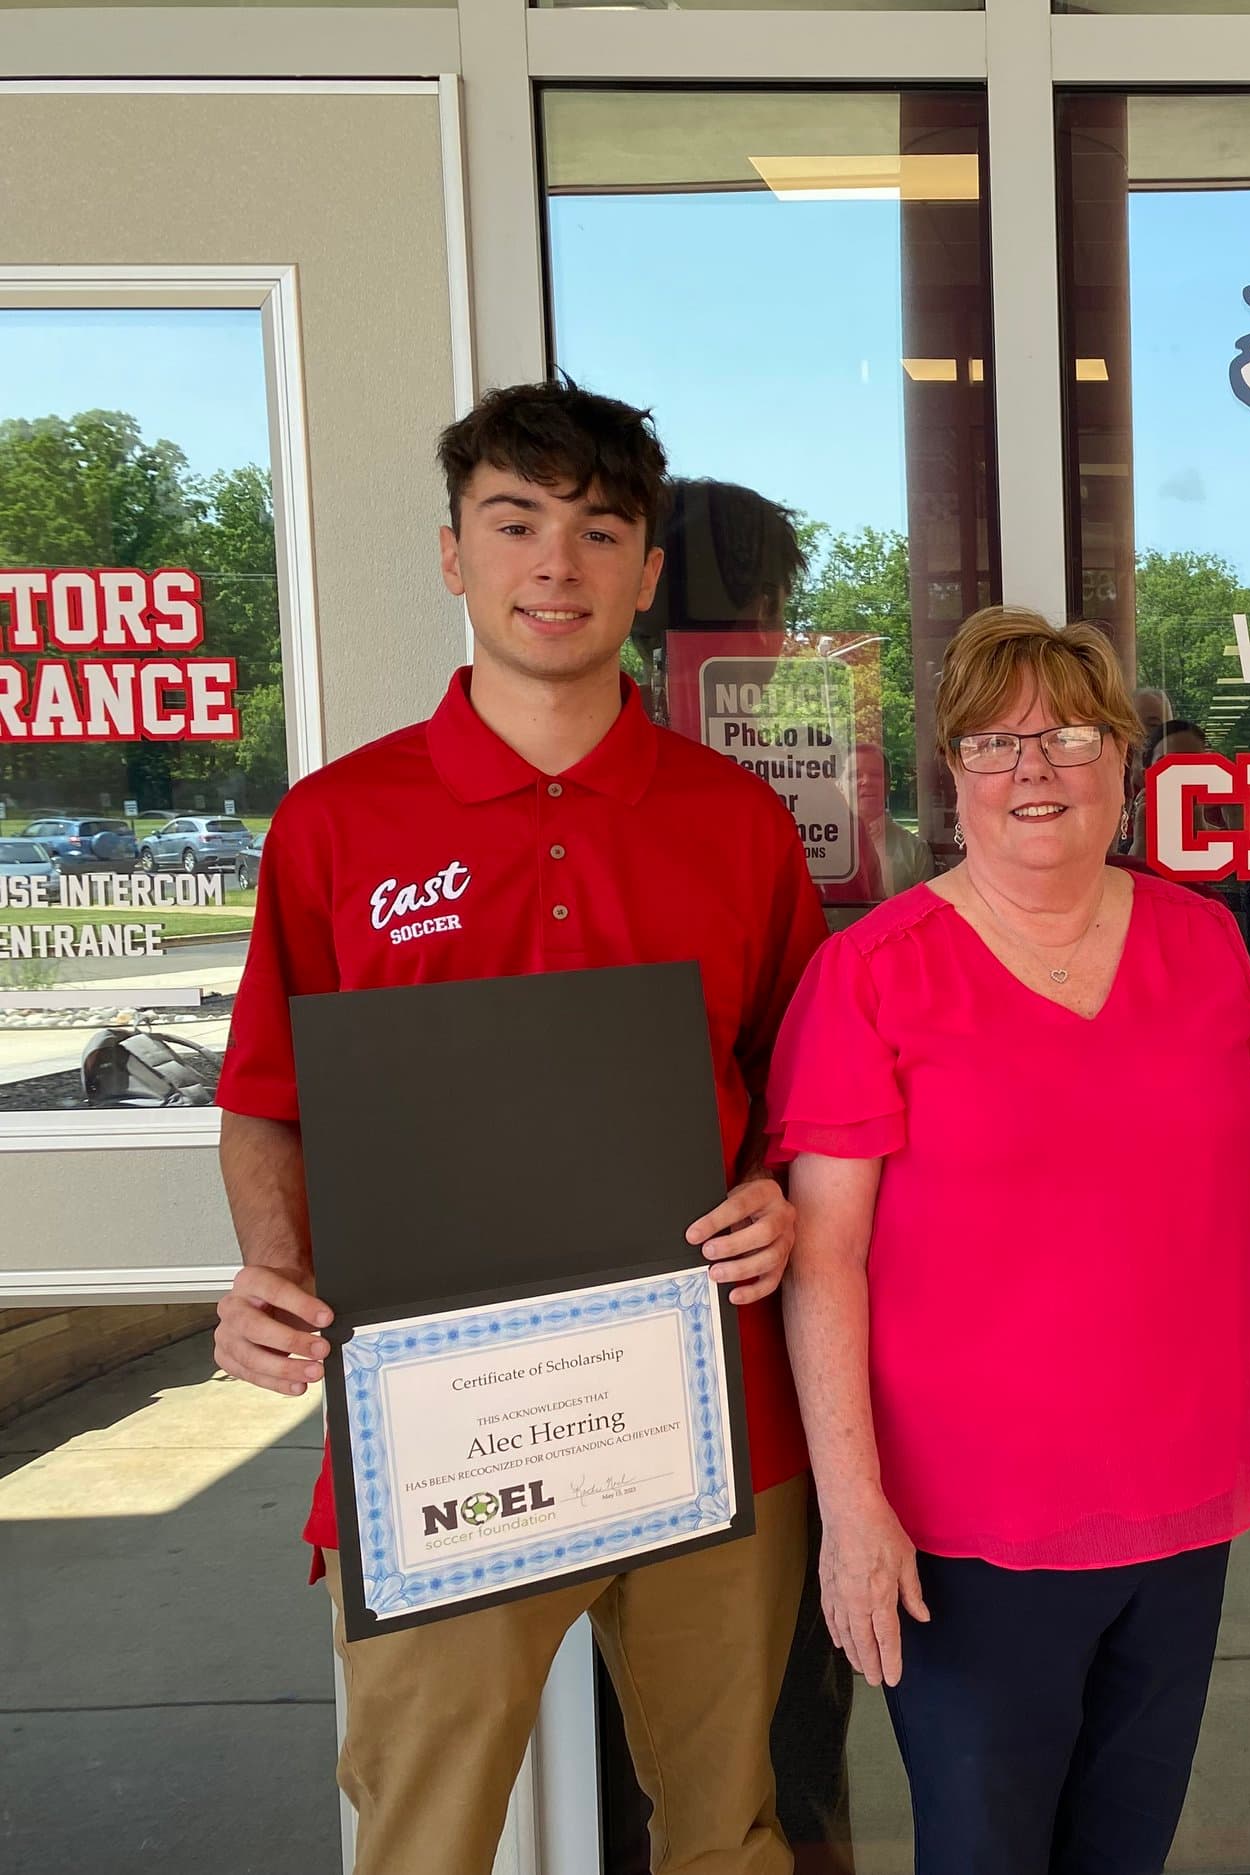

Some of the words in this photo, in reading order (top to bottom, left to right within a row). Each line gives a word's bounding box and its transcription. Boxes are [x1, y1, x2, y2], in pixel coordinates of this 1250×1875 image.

[715, 683, 841, 714] NOTICE
[724, 722, 798, 747] Photo
[807, 722, 833, 747] ID
[722, 754, 837, 784] equired
[60, 873, 224, 907] INTERCOM
[370, 861, 471, 929] East
[389, 914, 462, 945] SOCCER
[452, 1369, 526, 1391] Certificate
[528, 1362, 544, 1376] of
[546, 1348, 624, 1373] Scholarship
[478, 1414, 501, 1426] THIS
[502, 1396, 583, 1422] ACKNOWLEDGES
[584, 1391, 609, 1404] THAT
[466, 1433, 523, 1459] Alec
[529, 1411, 626, 1446] Herring
[405, 1479, 428, 1492] HAS
[429, 1473, 456, 1487] BEEN
[458, 1459, 523, 1480] RECOGNIZED
[525, 1454, 544, 1466] FOR
[545, 1438, 615, 1461] OUTSTANDING
[615, 1421, 682, 1444] ACHIEVEMENT
[425, 1531, 474, 1551] soccer
[478, 1511, 557, 1537] foundation
